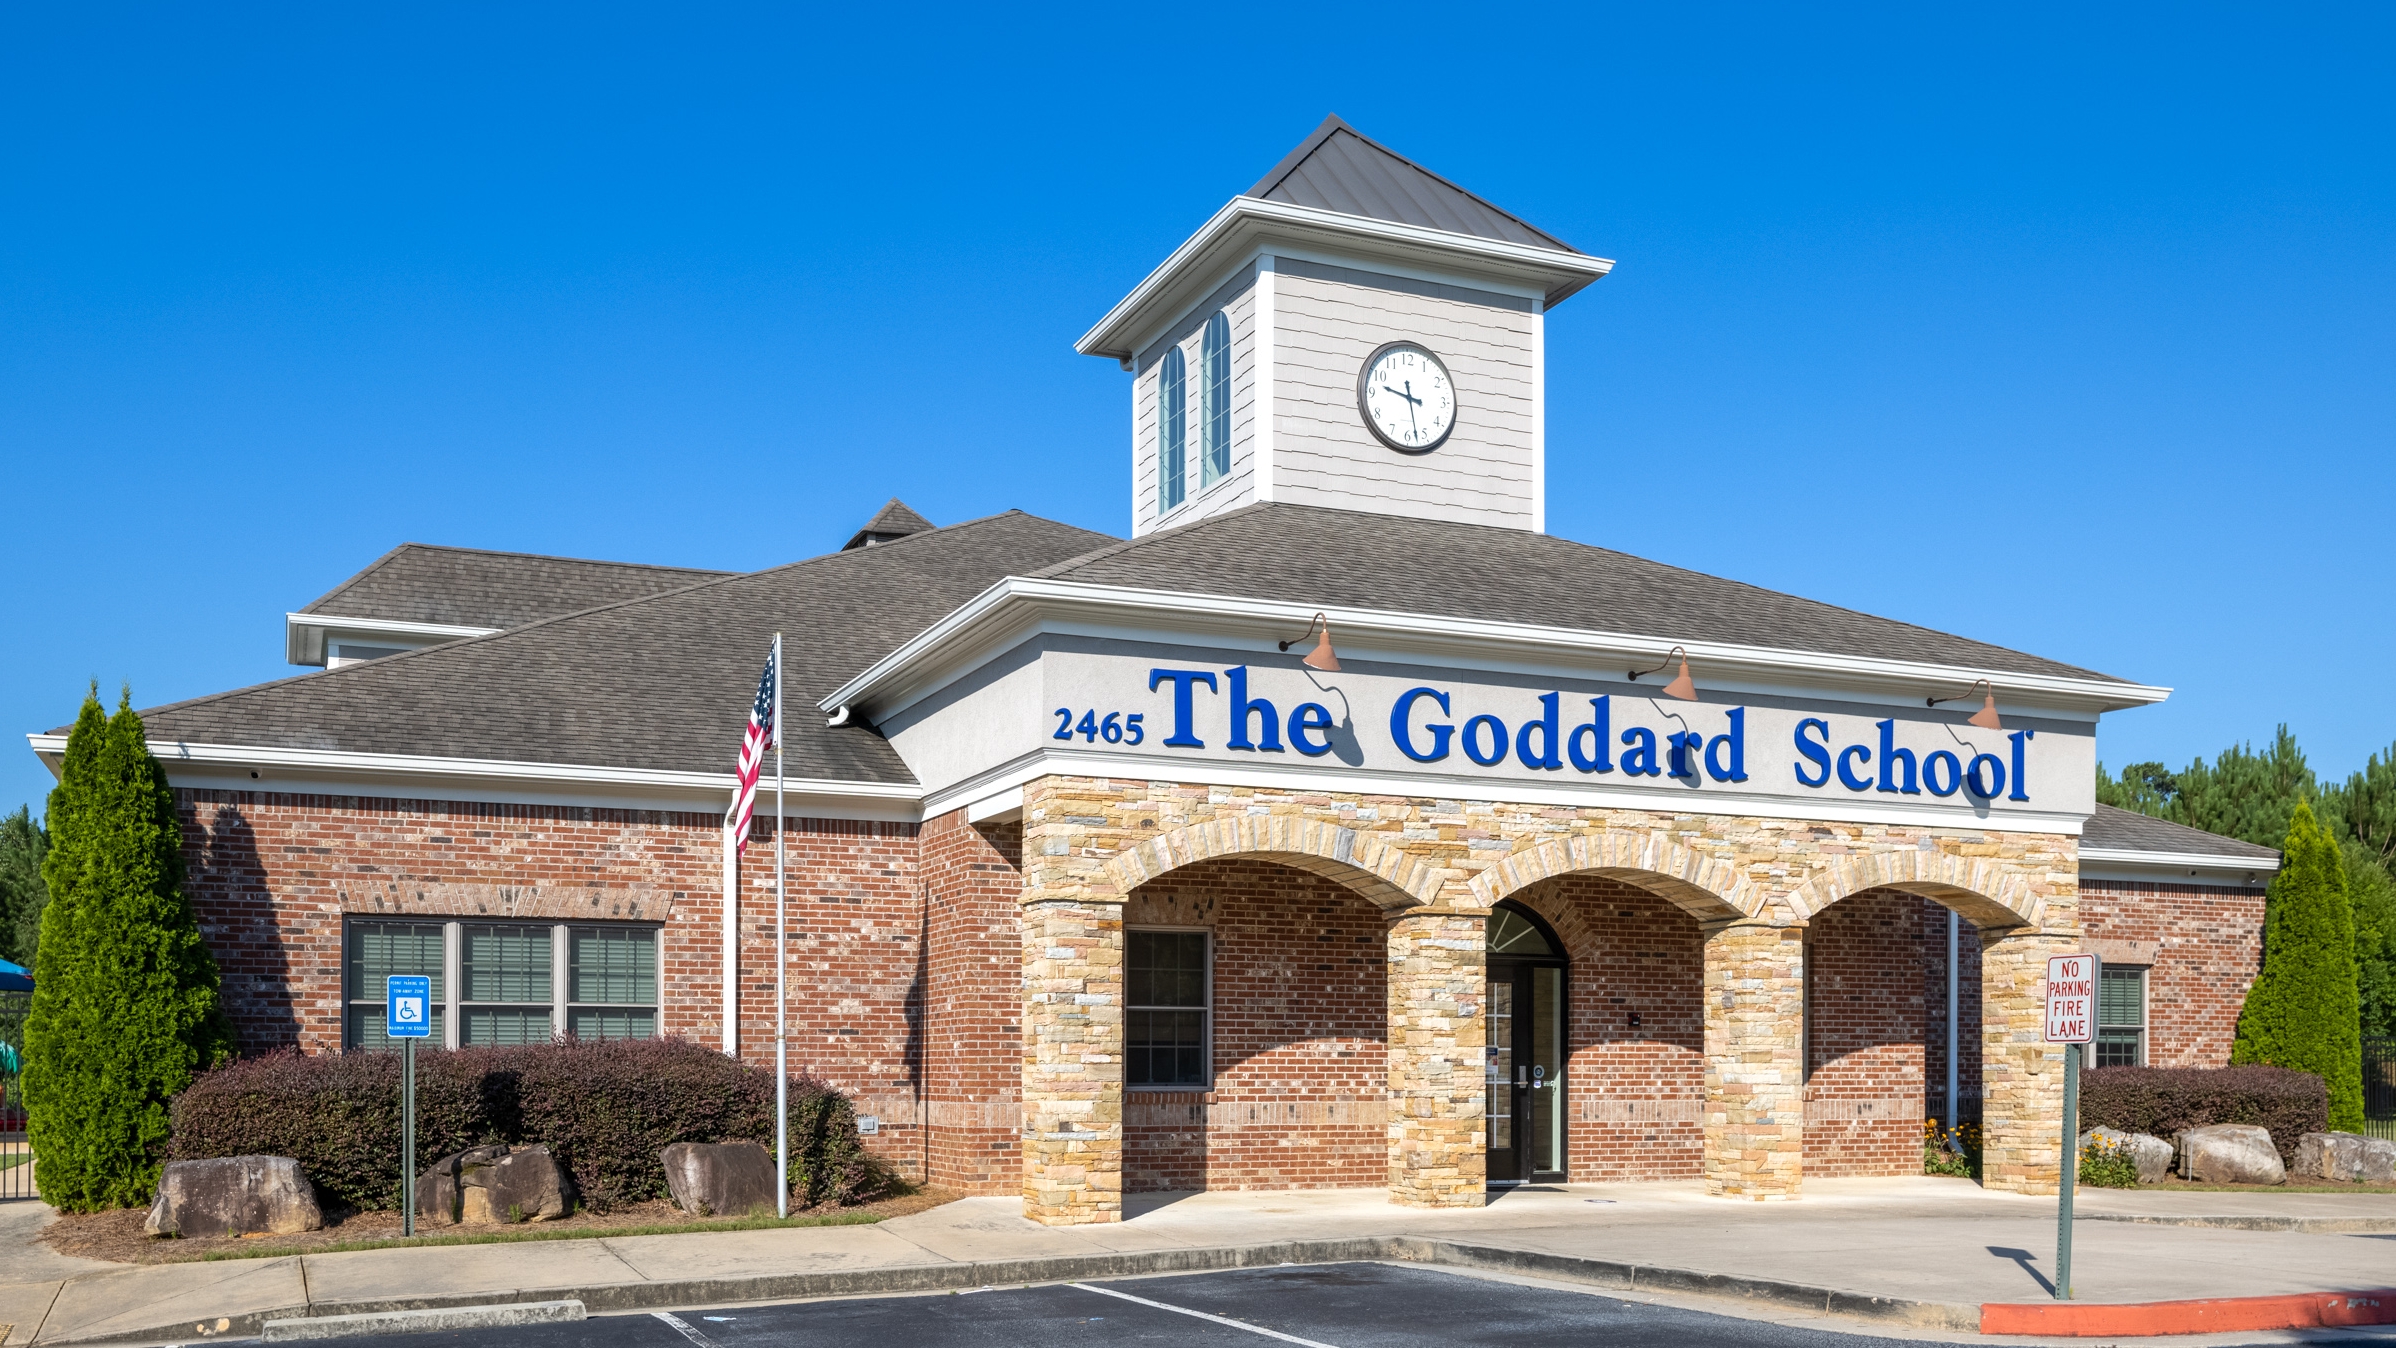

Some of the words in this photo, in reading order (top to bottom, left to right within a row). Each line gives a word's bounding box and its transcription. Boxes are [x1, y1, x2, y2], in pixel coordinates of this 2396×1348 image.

[1386, 357, 1396, 370] 11
[1402, 353, 1414, 366] 12
[1374, 369, 1387, 382] 10
[1434, 376, 1441, 388] 2
[1368, 387, 1376, 398] 9
[1440, 397, 1446, 409] 3
[1374, 407, 1381, 419] 8
[1433, 416, 1440, 427] 4
[1389, 423, 1396, 435] 7
[1404, 430, 1411, 441] 6
[1421, 427, 1428, 440] 5
[1053, 707, 1145, 746] 2465
[1148, 665, 1335, 756] The
[1389, 686, 1749, 782] Goddard
[1793, 717, 2031, 802] School
[2061, 961, 2079, 978] NO
[2049, 980, 2090, 997] PARKING
[2054, 1000, 2084, 1017] FIRE
[2050, 1020, 2085, 1036] LANE
